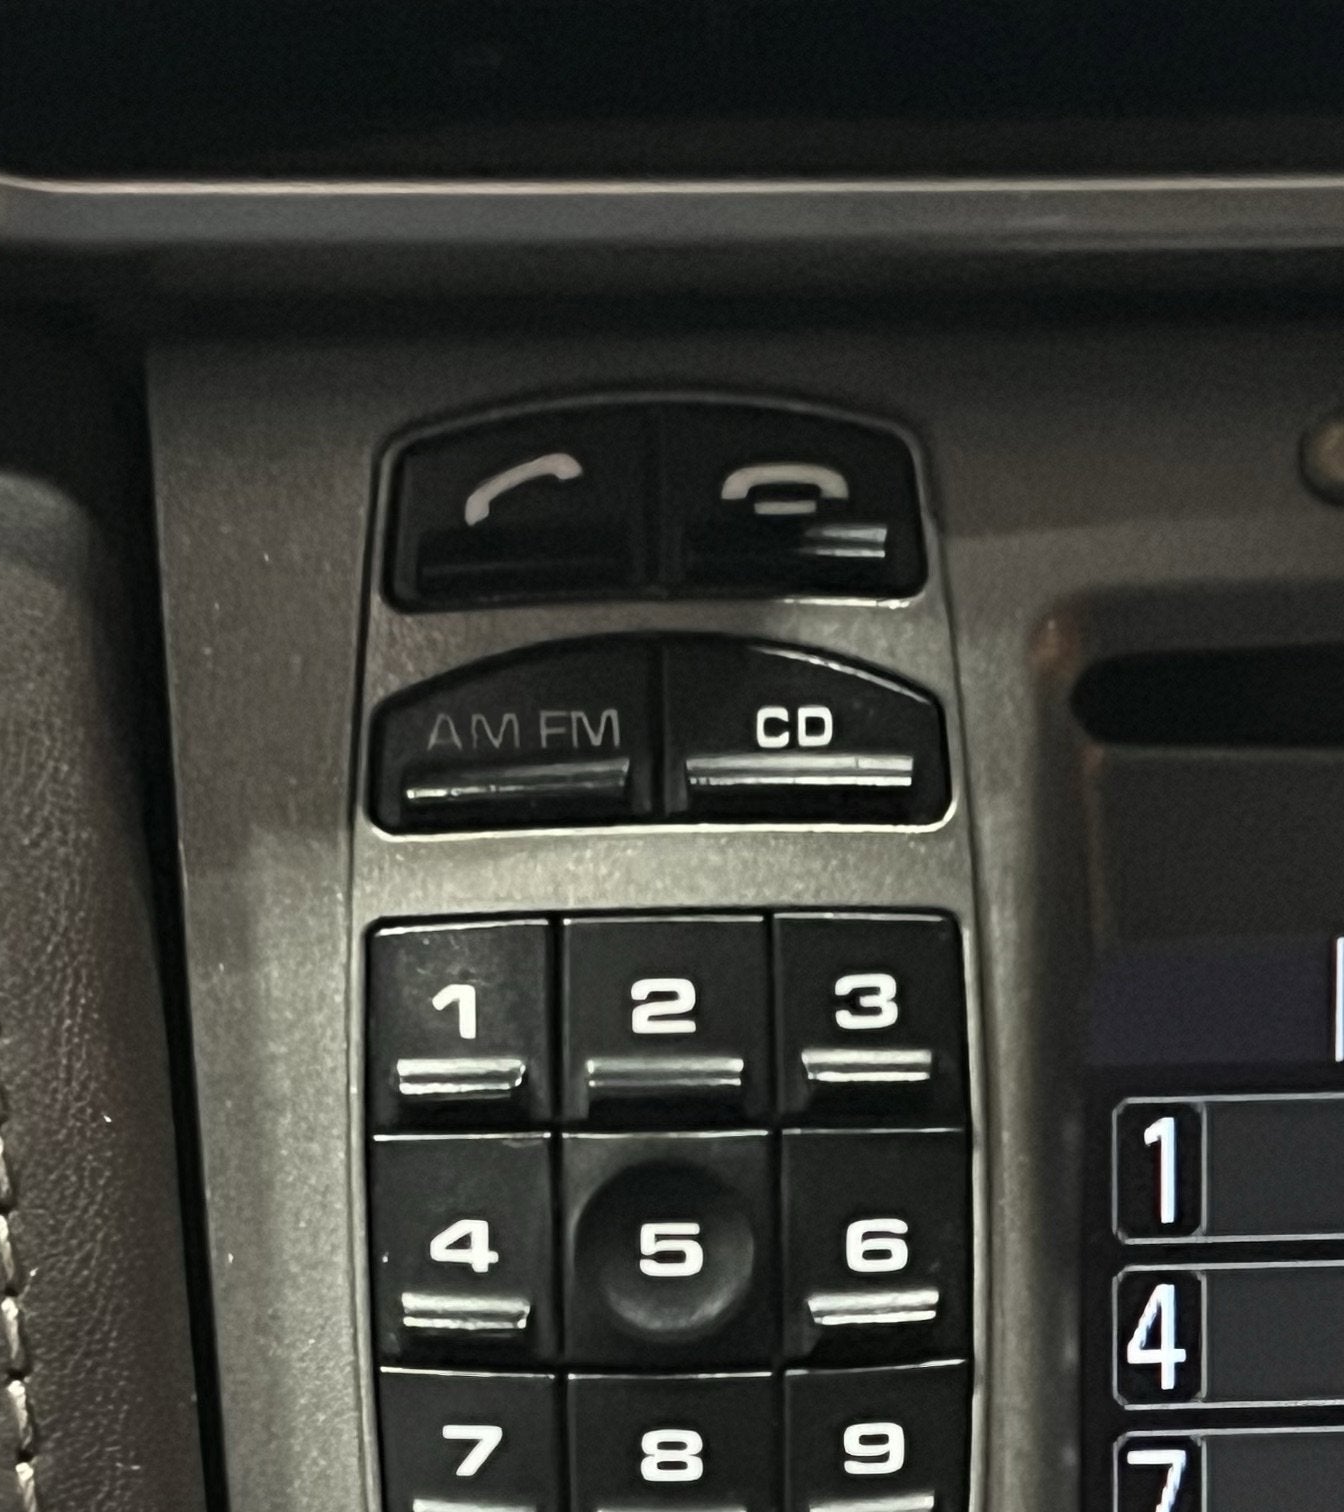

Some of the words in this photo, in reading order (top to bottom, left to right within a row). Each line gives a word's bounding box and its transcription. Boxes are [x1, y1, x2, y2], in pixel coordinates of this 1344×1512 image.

[427, 710, 520, 752] AM
[539, 708, 620, 748] FM
[756, 706, 833, 748] CD
[431, 983, 477, 1040] 1
[630, 978, 697, 1034] 2
[834, 973, 899, 1030] 3
[1143, 1116, 1176, 1224] 1
[429, 1219, 499, 1273] 4
[639, 1222, 704, 1277] 5
[845, 1218, 909, 1273] 6
[1126, 1283, 1187, 1391] 4
[442, 1424, 503, 1477] 7
[640, 1428, 704, 1482] 8
[843, 1422, 905, 1475] 9
